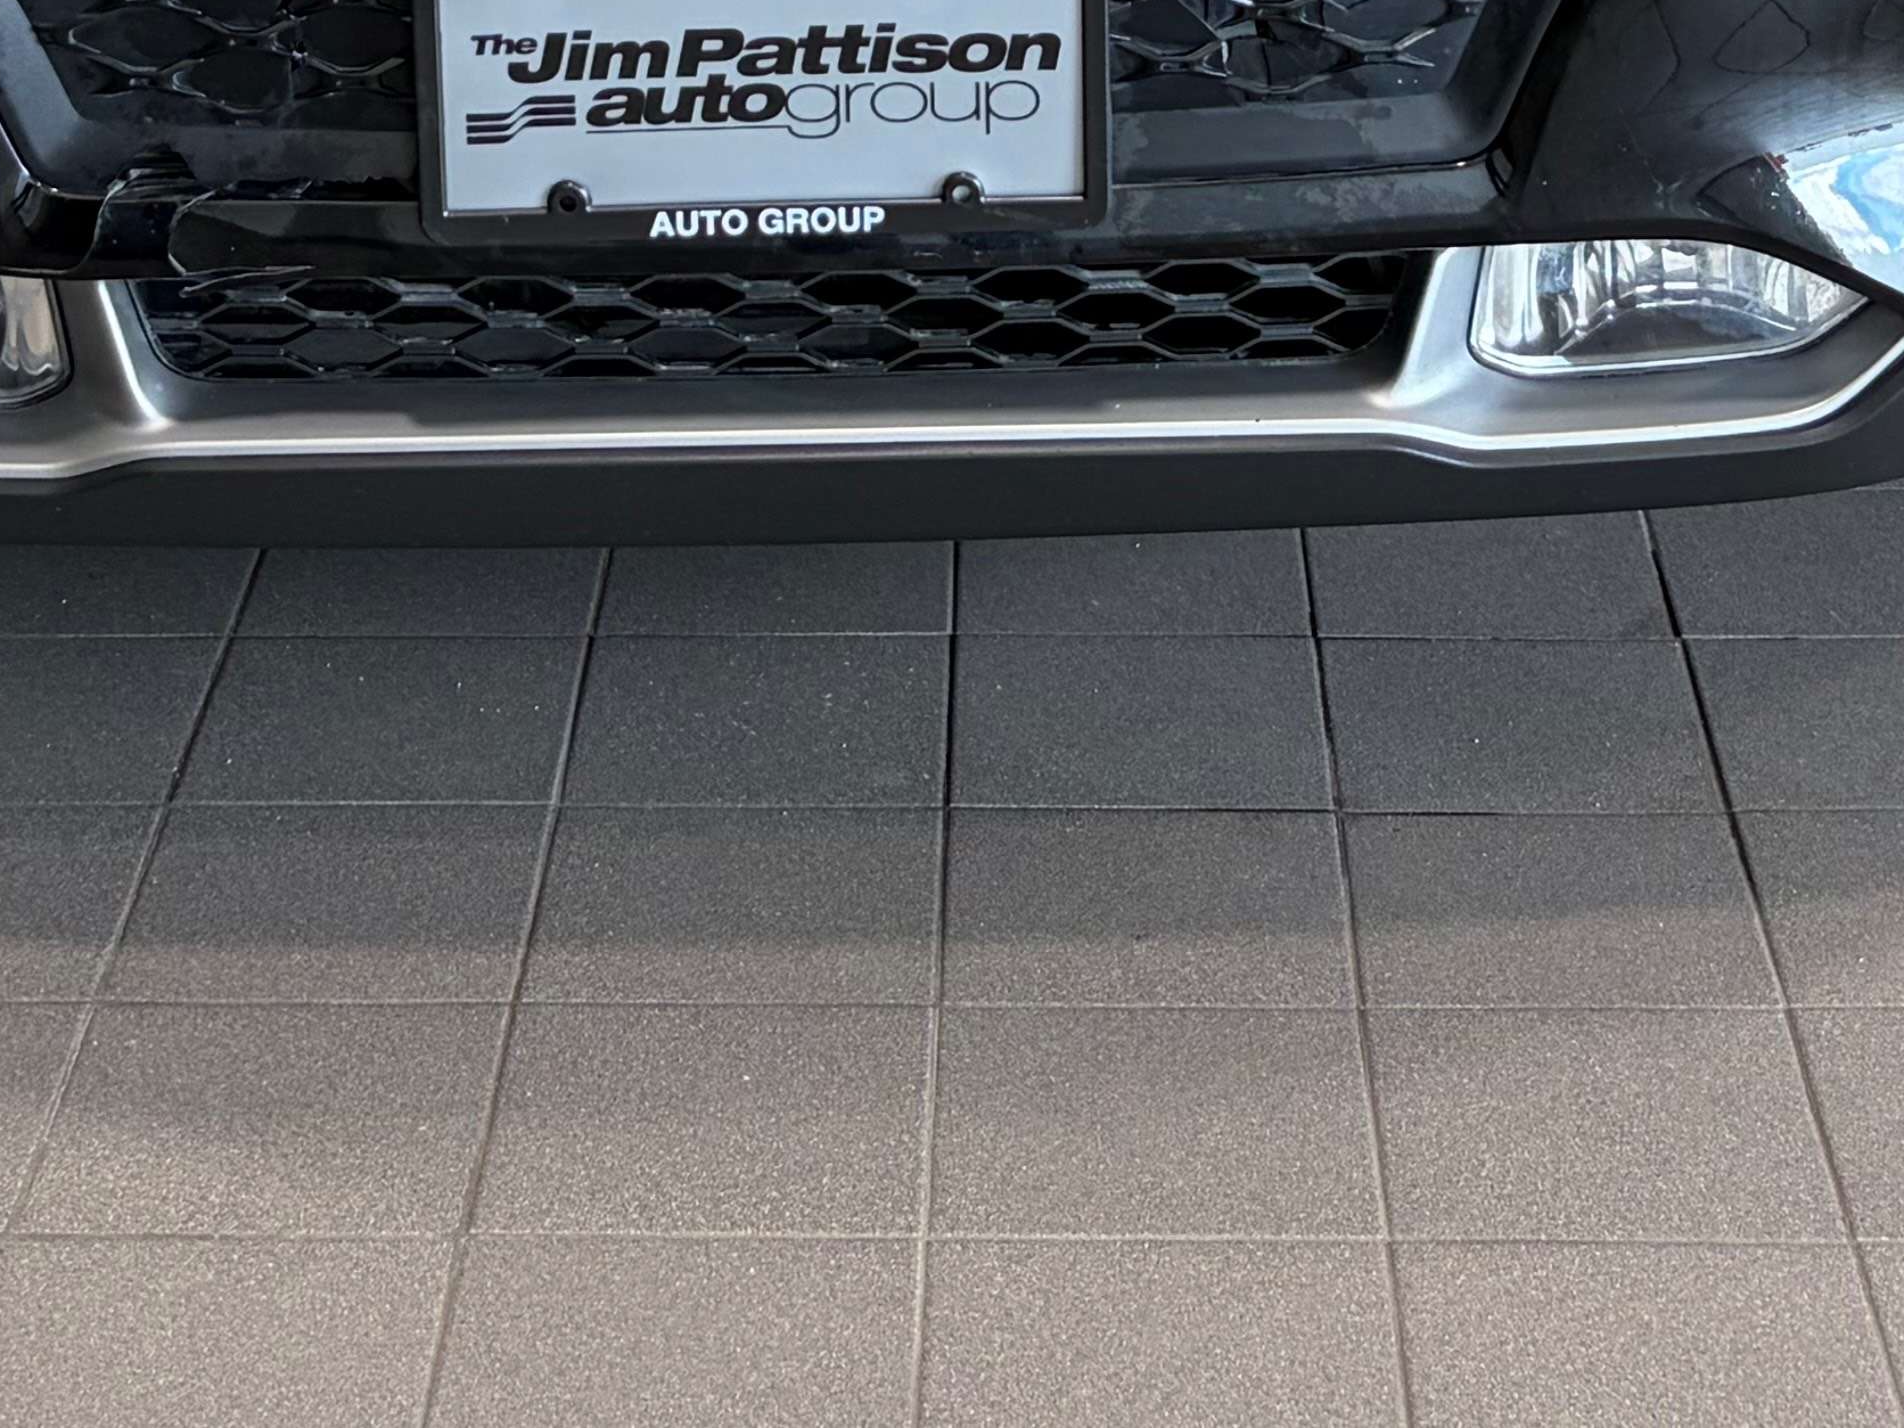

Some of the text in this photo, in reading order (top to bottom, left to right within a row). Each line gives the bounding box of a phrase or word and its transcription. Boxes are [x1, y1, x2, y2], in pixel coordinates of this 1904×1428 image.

[470, 22, 1062, 84] The Jim Pattison
[649, 206, 886, 238] AUTO GROUP
